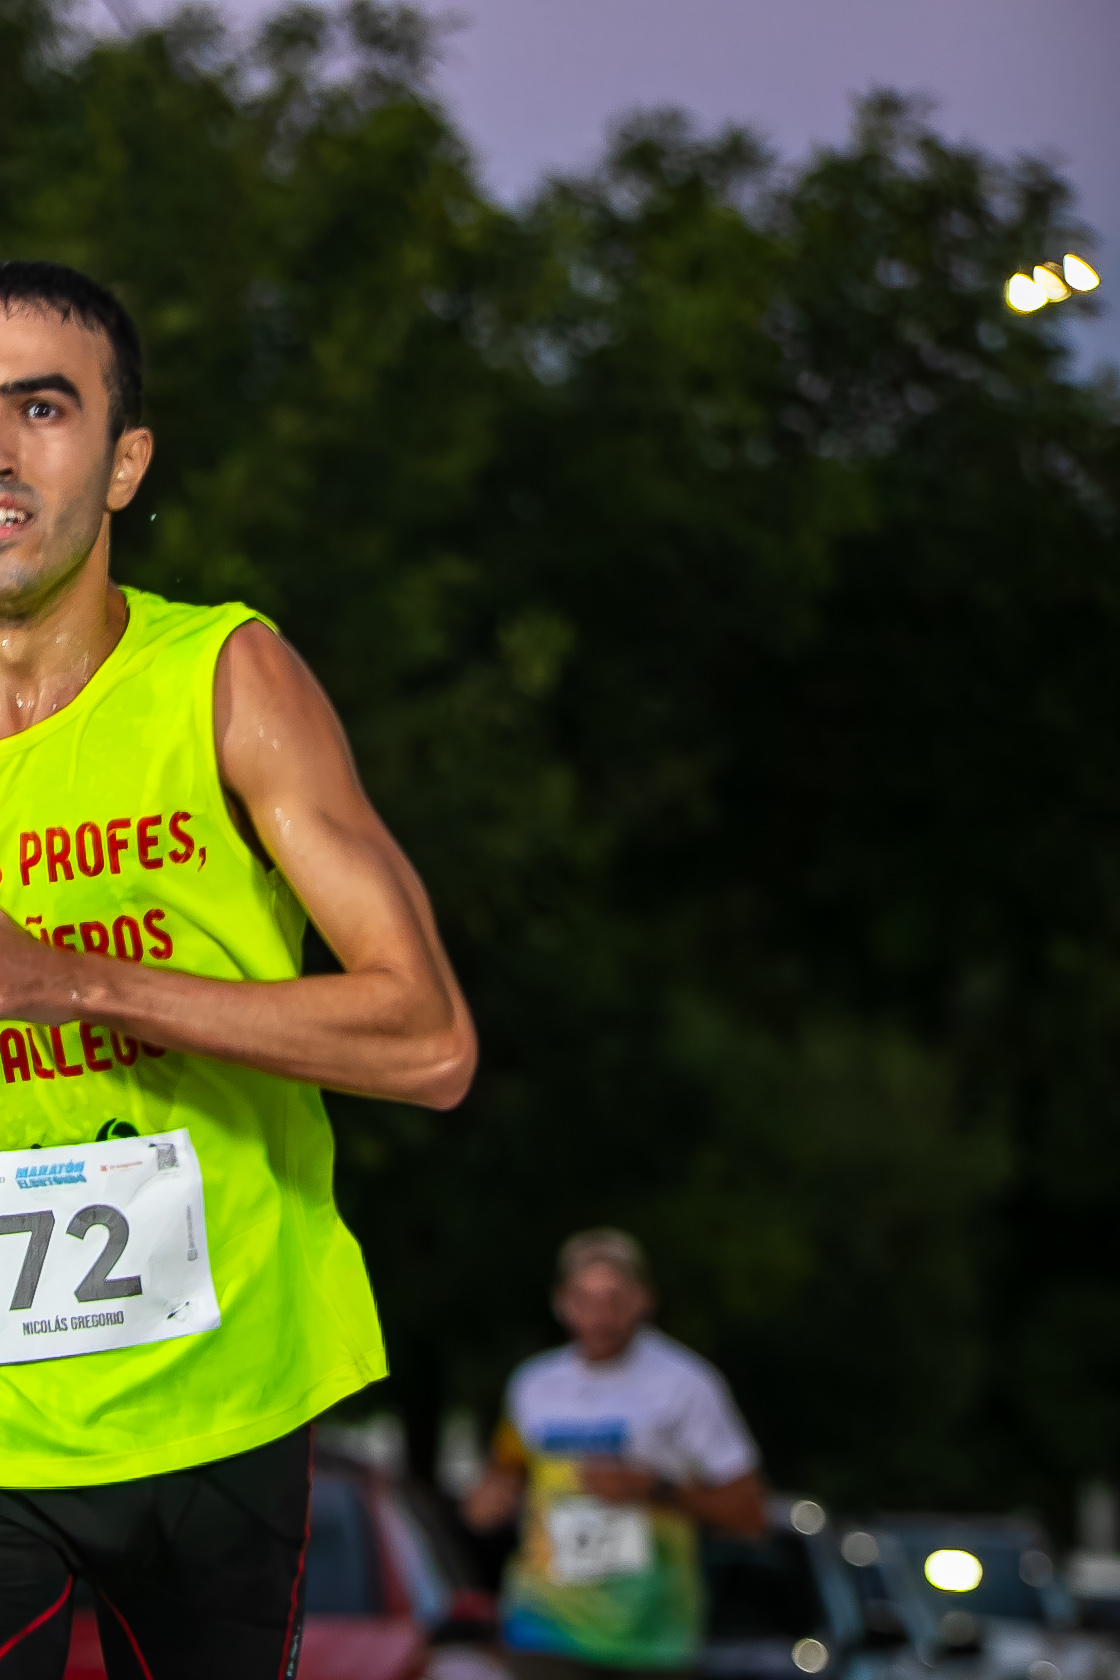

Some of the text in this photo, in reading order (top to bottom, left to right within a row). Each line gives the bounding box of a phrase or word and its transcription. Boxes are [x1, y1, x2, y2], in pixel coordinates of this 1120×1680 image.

[20, 811, 207, 886] PROFES,
[22, 1310, 125, 1336] NICOLÁS GREGORIO
